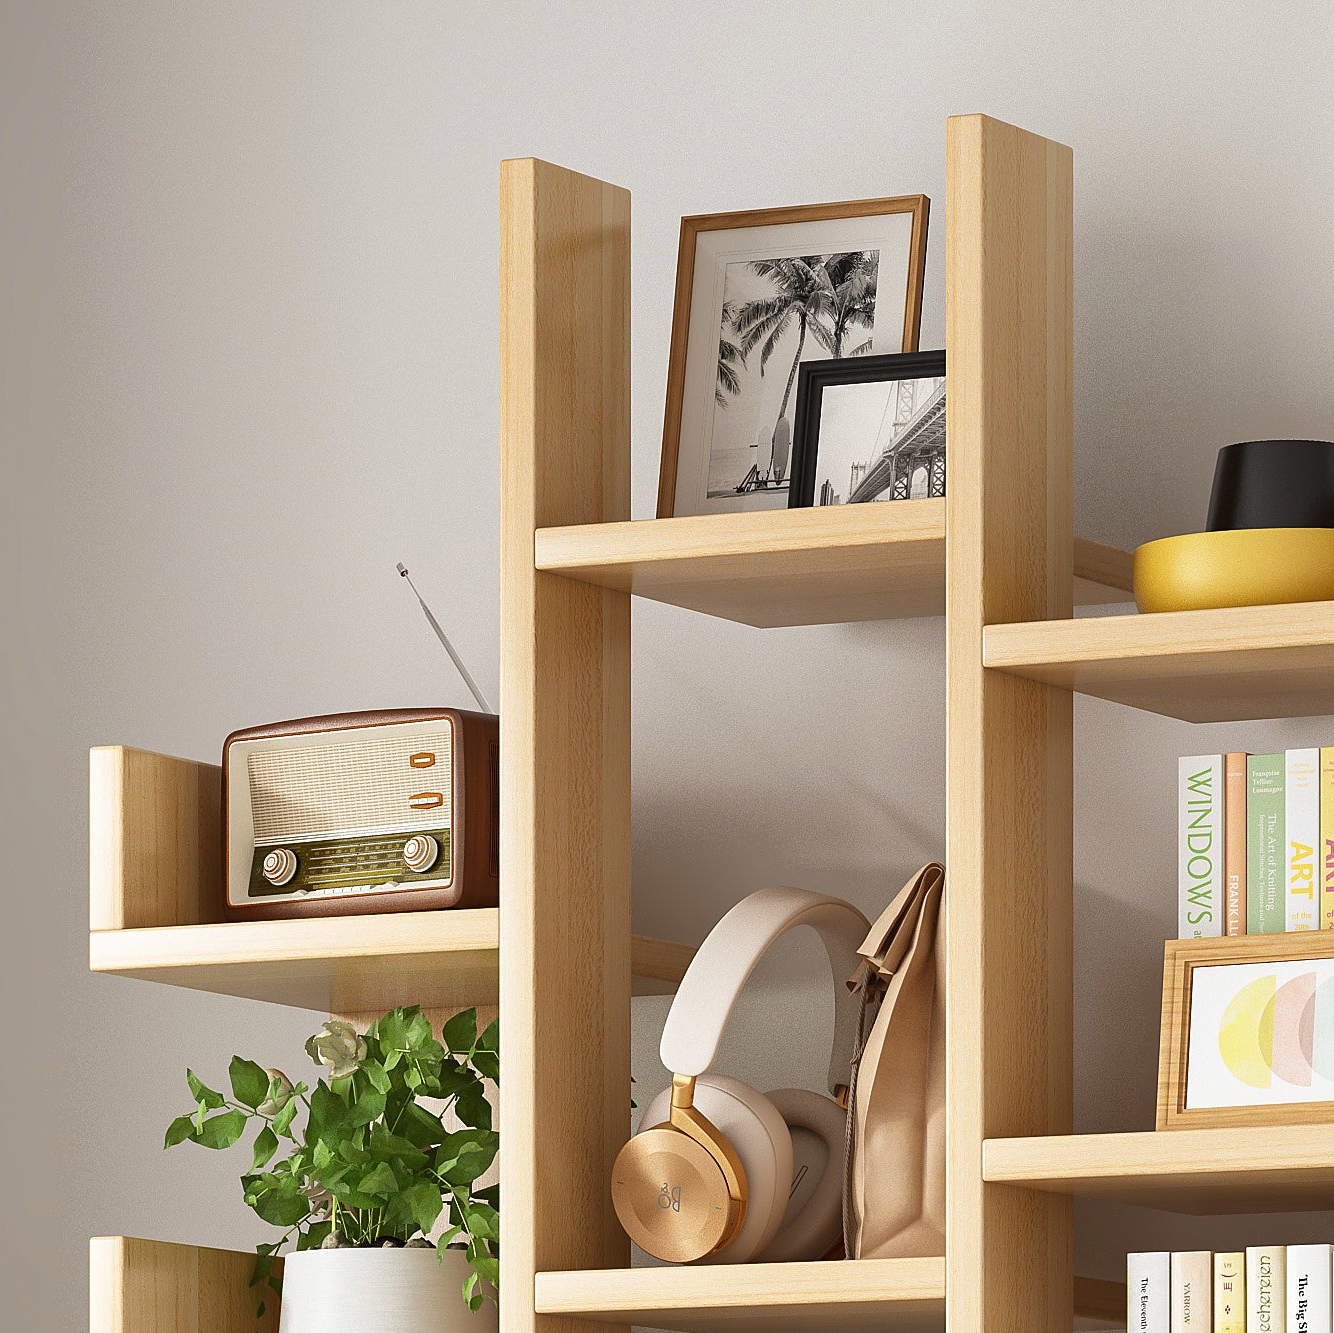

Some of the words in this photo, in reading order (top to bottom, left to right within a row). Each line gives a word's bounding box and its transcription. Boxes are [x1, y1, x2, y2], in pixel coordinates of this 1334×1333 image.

[1186, 766, 1213, 925] WINDOWS
[1289, 838, 1316, 900] ART
[1228, 875, 1240, 919] FRANK
[1140, 1277, 1149, 1294] The
[1298, 1273, 1309, 1297] The
[1140, 1295, 1149, 1330] Eleventh
[1295, 1299, 1308, 1321] Big
